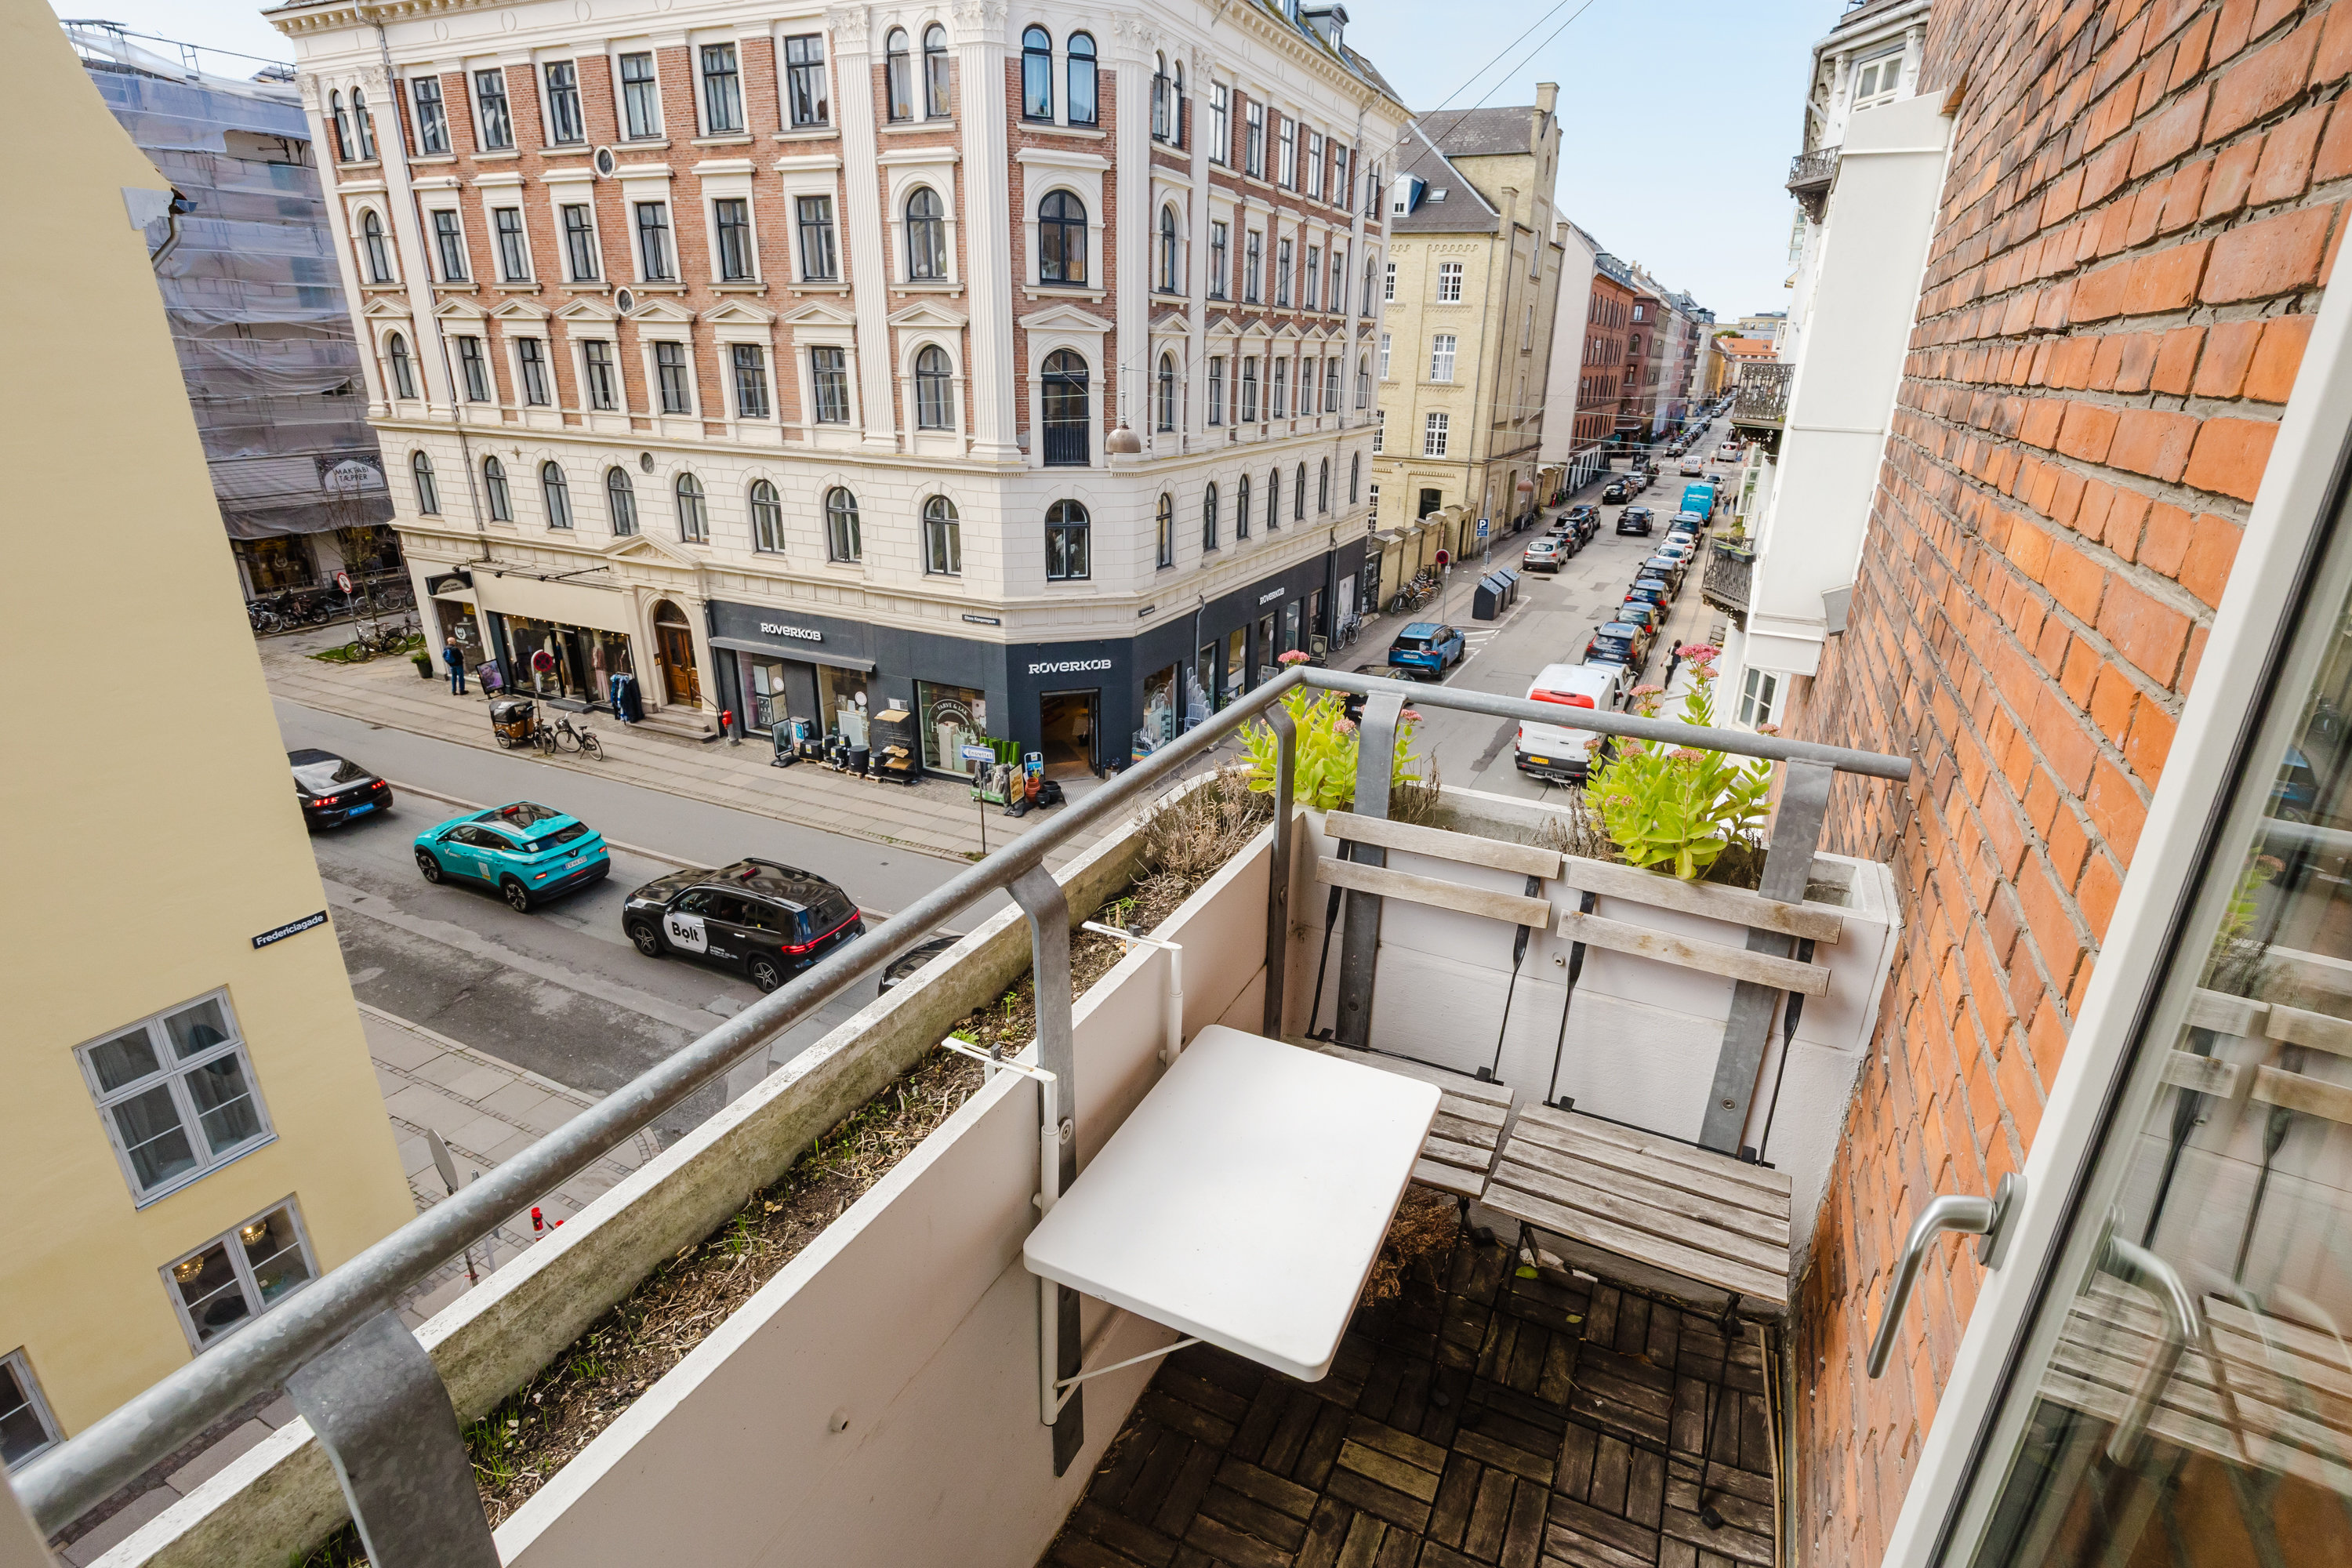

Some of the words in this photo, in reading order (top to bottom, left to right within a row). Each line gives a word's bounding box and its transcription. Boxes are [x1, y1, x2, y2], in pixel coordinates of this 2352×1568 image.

[335, 466, 369, 475] MAKTABI
[339, 474, 368, 482] TÆPPER
[1479, 519, 1486, 529] P
[937, 702, 952, 711] FARVE
[958, 706, 968, 716] LAK
[968, 750, 992, 758] Ensrettet
[256, 915, 324, 946] Fredericiagade
[671, 921, 699, 943] Bolt
